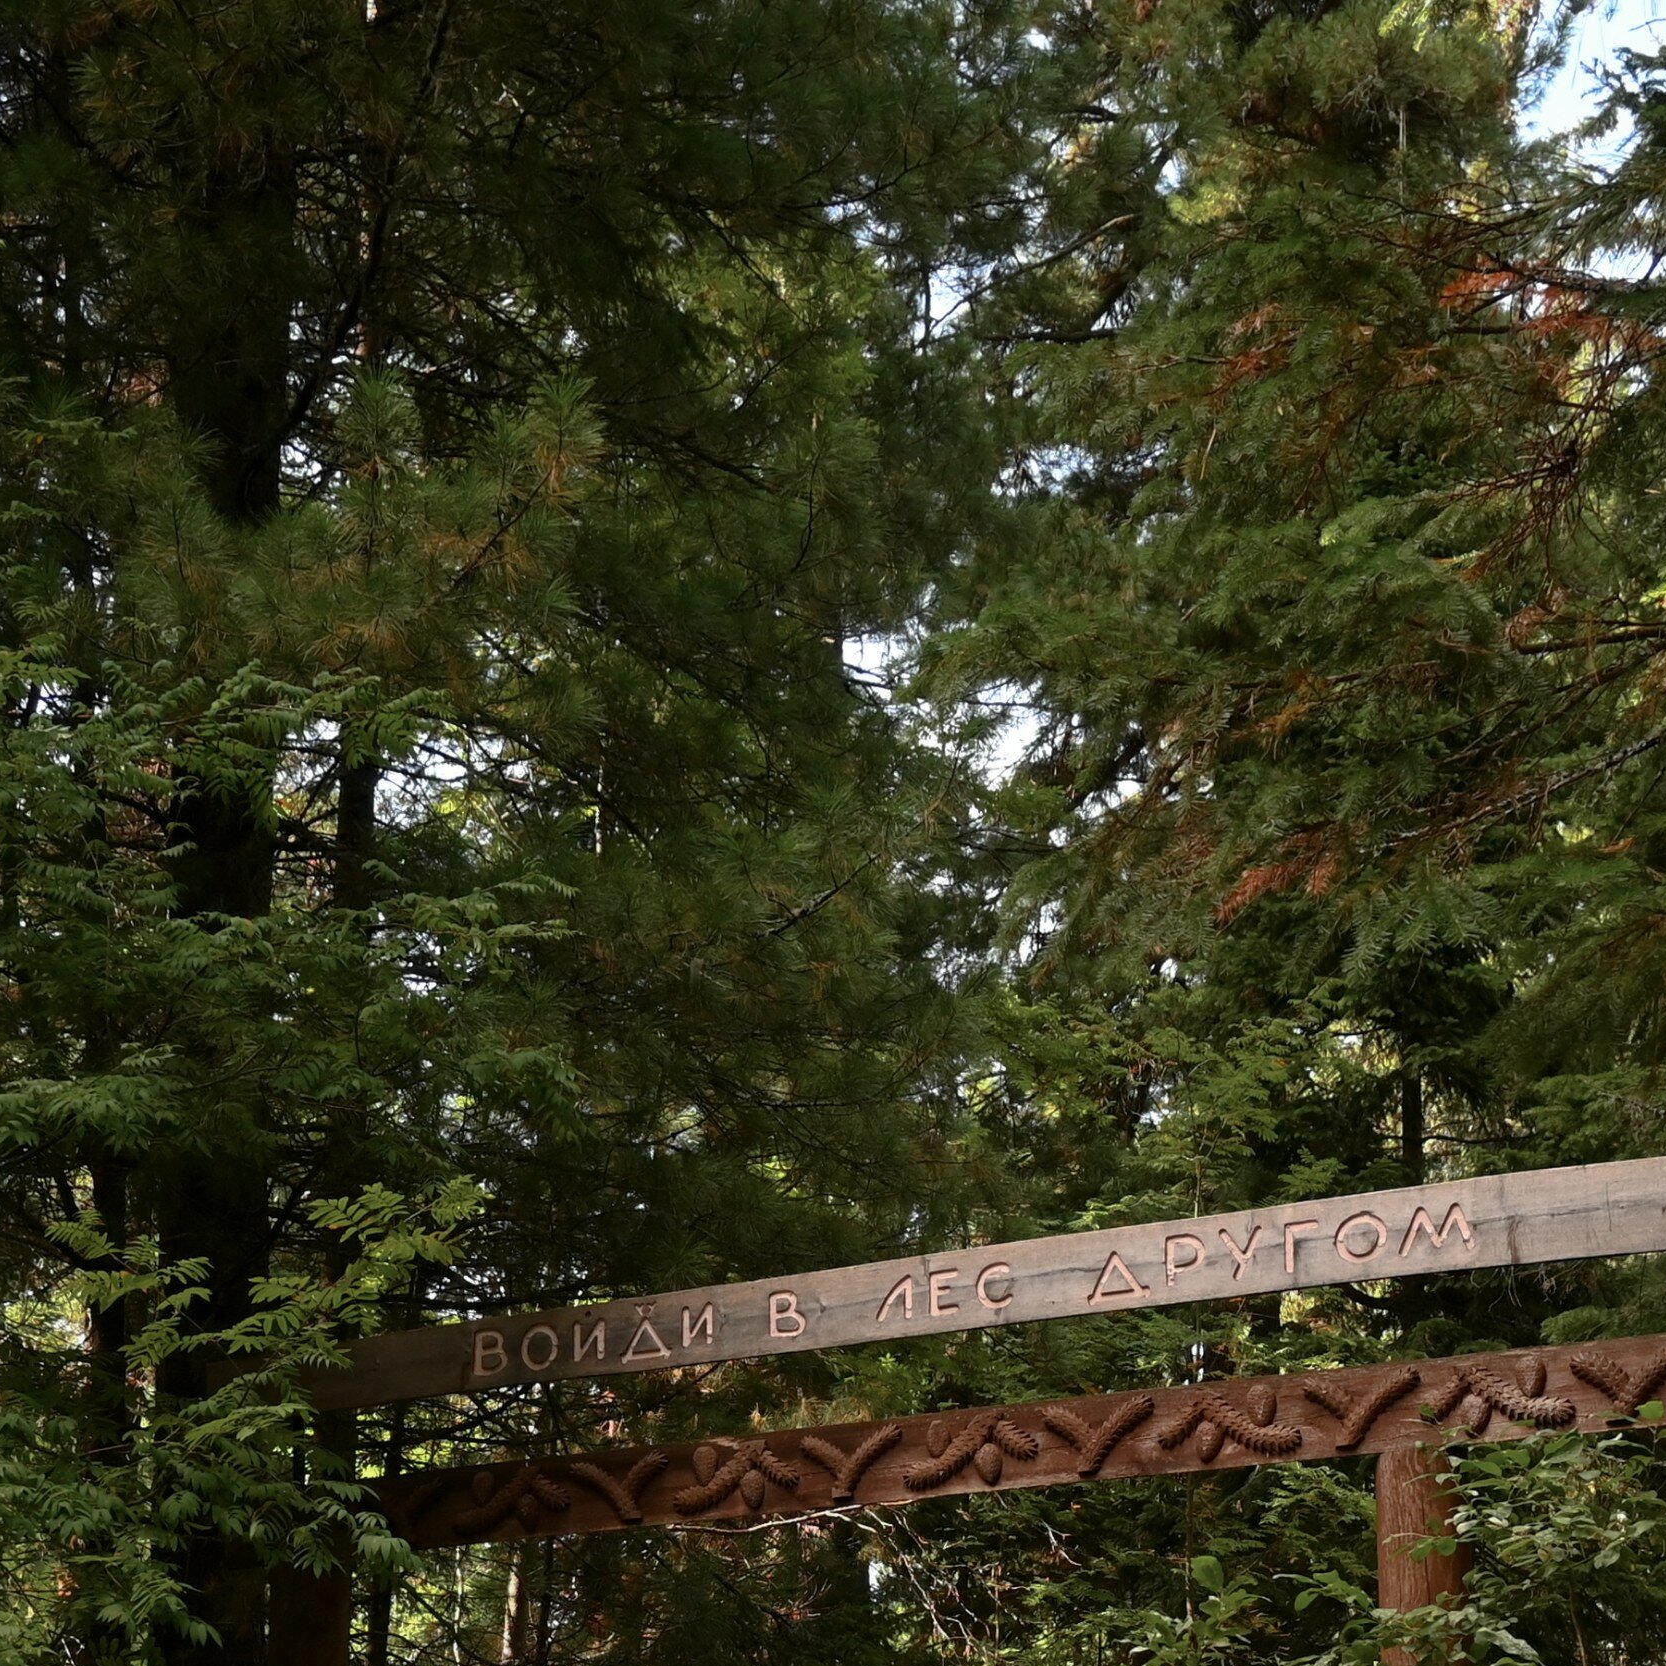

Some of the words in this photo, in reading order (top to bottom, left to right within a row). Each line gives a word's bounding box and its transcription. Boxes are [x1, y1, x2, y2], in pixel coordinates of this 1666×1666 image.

[768, 1289, 807, 1339] В
[875, 1262, 1013, 1322] ЛЕС
[1087, 1202, 1477, 1306] ДРУГОМ
